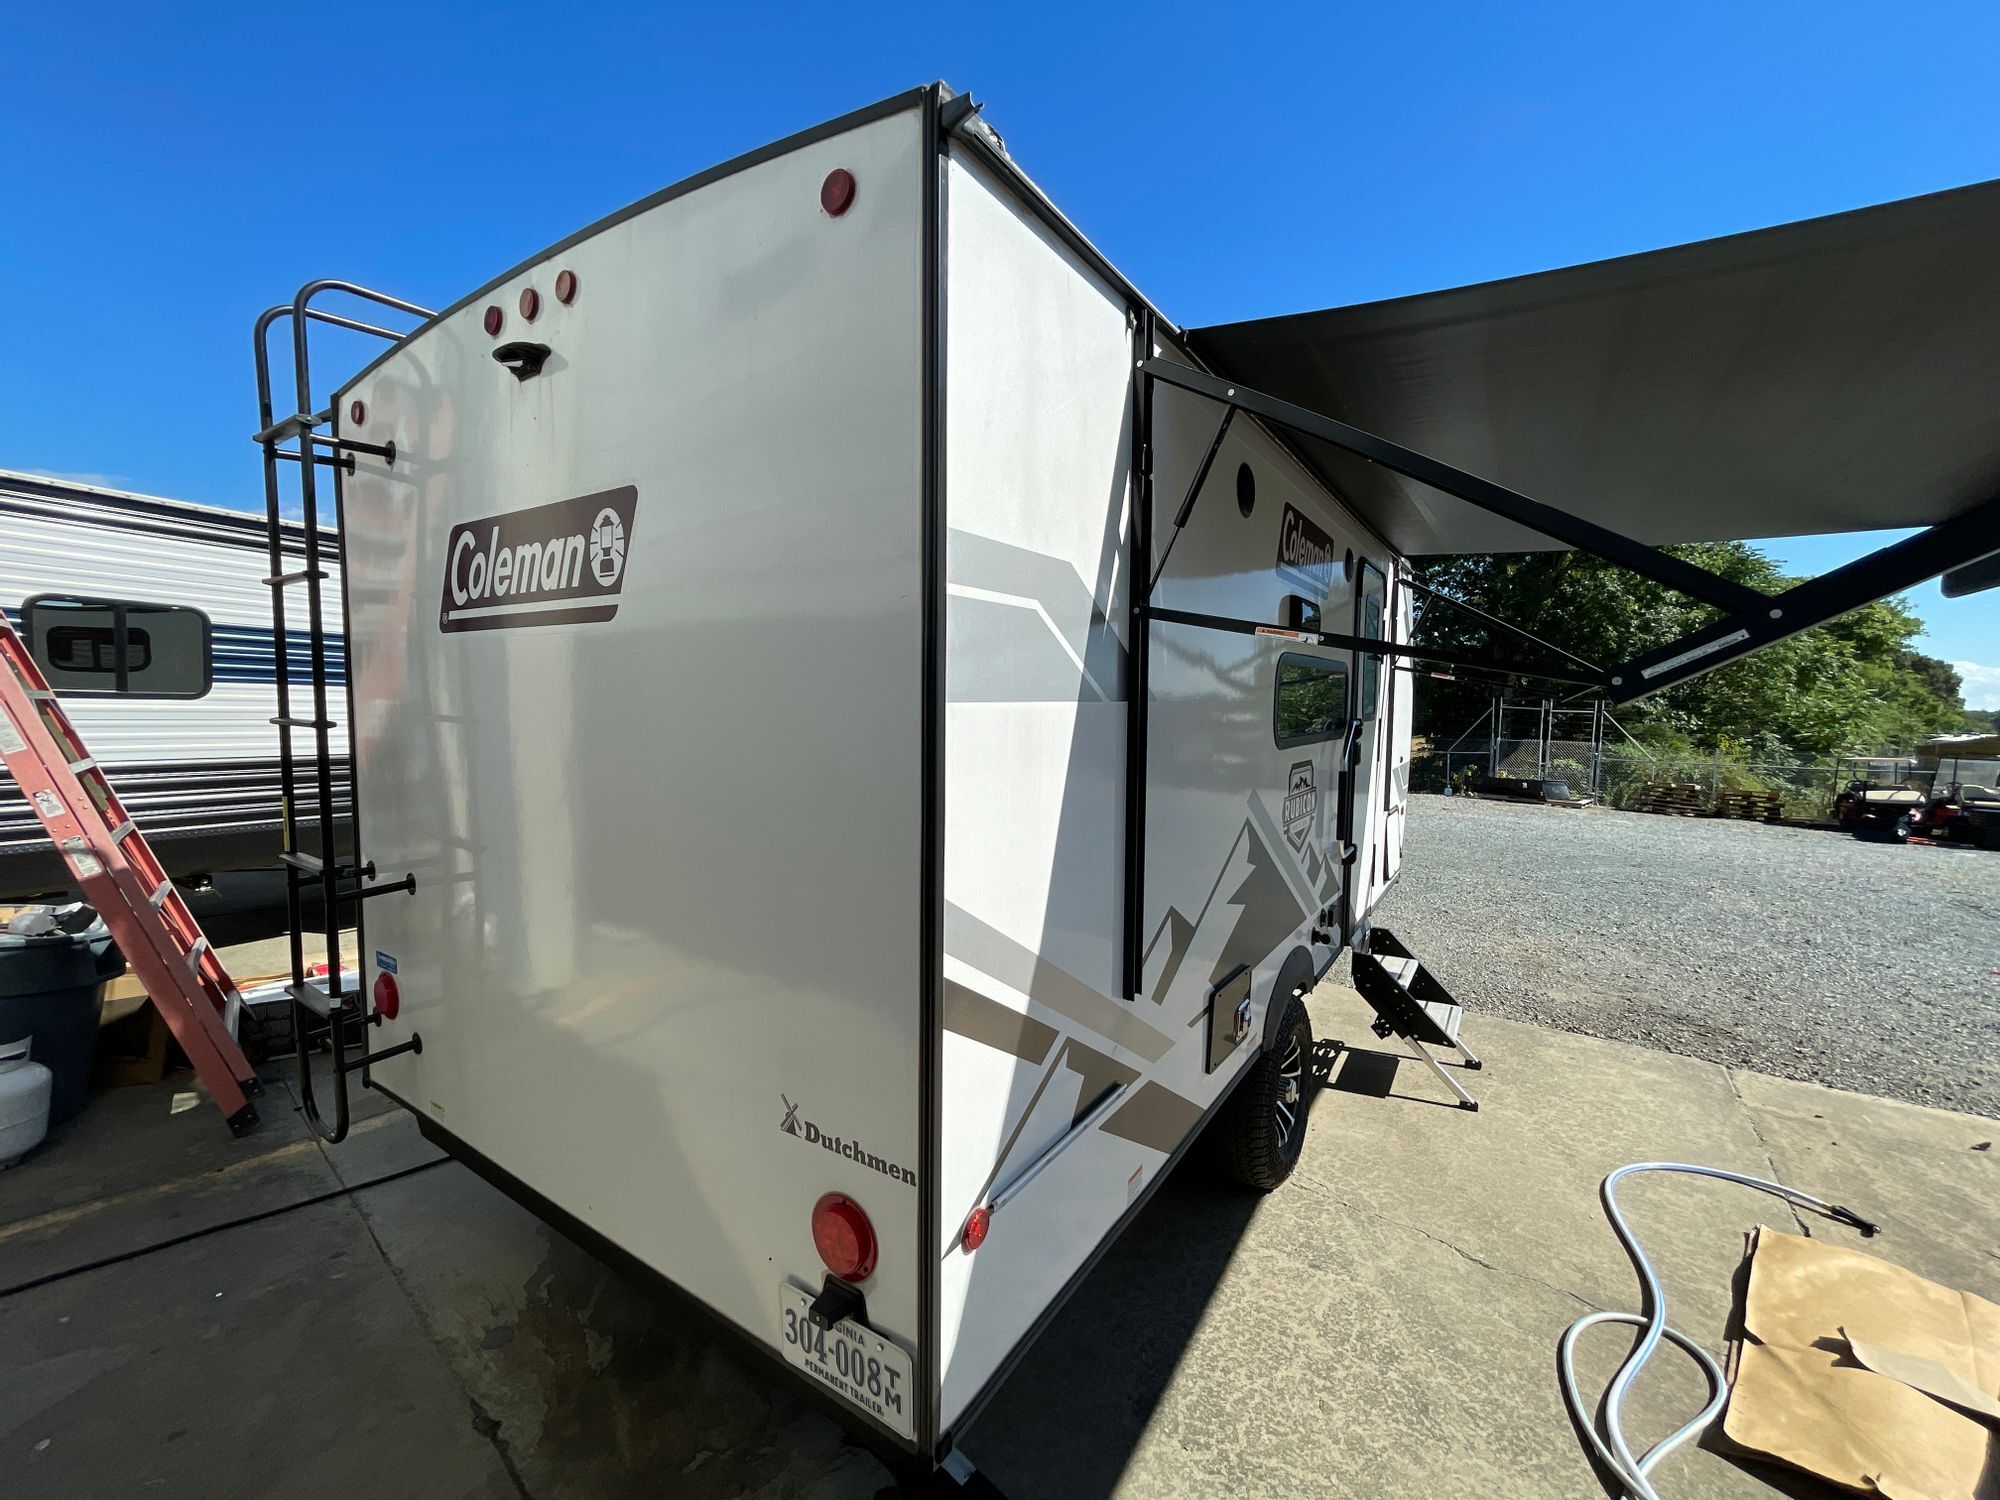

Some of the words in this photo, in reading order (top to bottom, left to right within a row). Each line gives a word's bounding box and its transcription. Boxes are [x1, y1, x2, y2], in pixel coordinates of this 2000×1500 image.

[452, 526, 585, 606] Coleman
[1283, 510, 1324, 577] Coleman
[804, 1121, 917, 1187] Dutchmen
[785, 1308, 881, 1397] 304-008
[804, 1358, 849, 1394] PERMANENT
[850, 1386, 884, 1417] TRAILER
